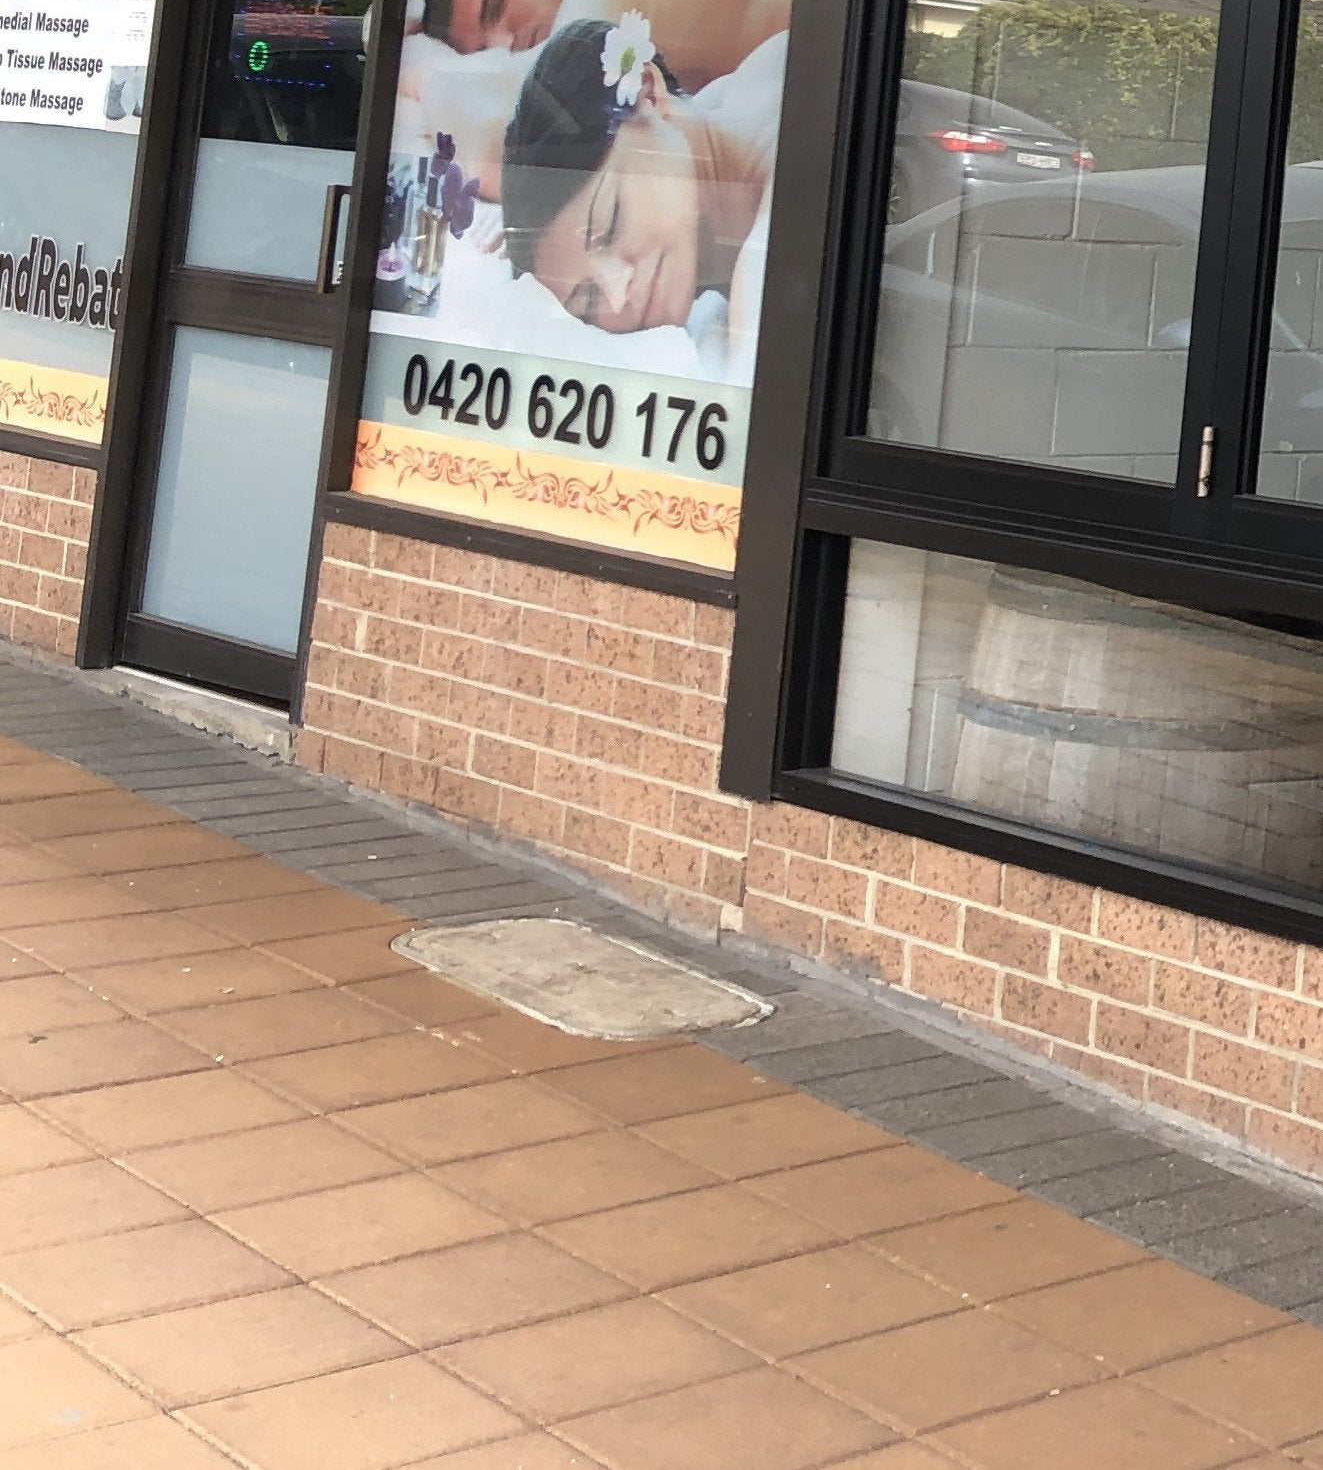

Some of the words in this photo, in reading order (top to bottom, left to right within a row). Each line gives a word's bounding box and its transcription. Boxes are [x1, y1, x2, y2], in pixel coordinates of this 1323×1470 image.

[35, 12, 89, 38] Massage
[7, 49, 45, 69] Tissue
[49, 51, 103, 78] Massage
[30, 88, 84, 115] Massage
[403, 354, 512, 430] 0420
[527, 374, 614, 449] 620
[636, 392, 728, 471] 176
